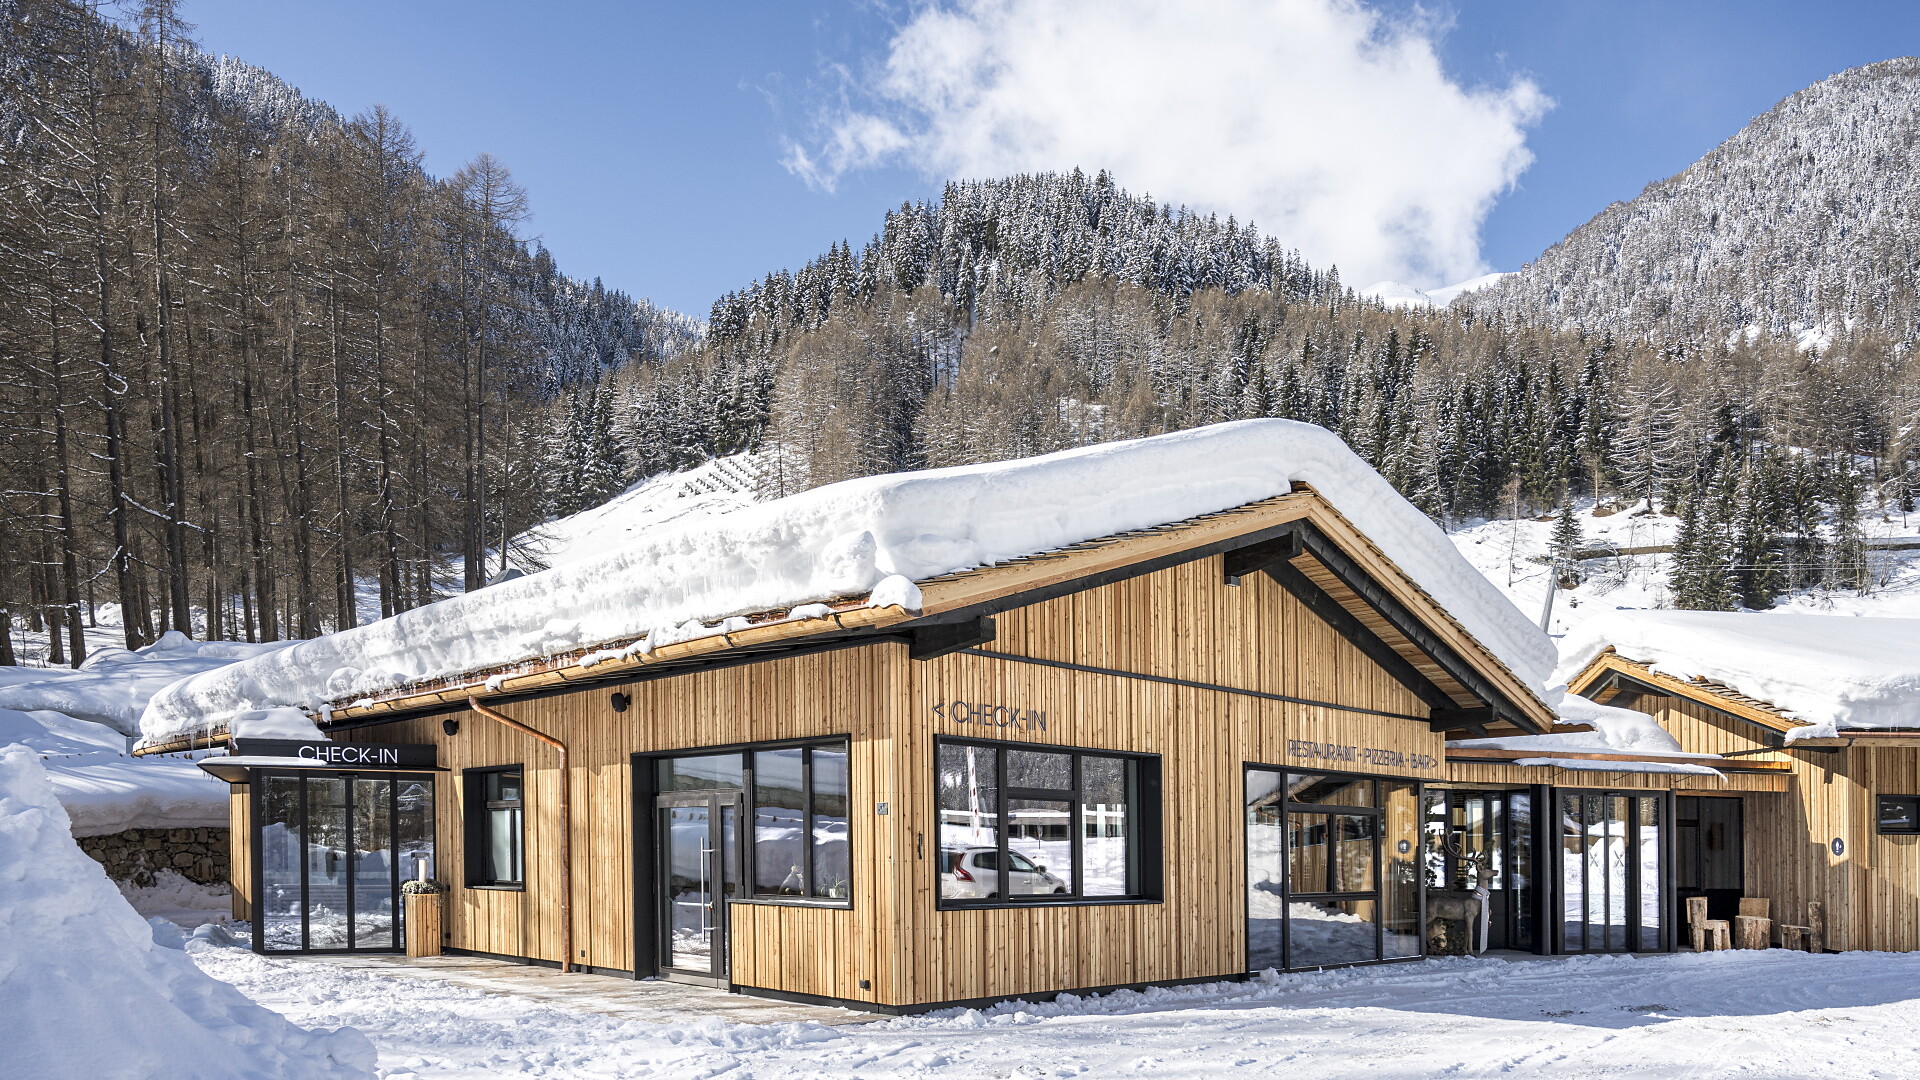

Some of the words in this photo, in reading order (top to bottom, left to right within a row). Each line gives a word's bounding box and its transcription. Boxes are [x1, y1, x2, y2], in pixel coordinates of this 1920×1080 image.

[951, 701, 1046, 731] CHECK-IN
[298, 745, 398, 764] CHECK-IN
[1287, 739, 1357, 763] RESTAURANT
[1363, 748, 1406, 768] PIZZERIA
[1410, 753, 1432, 770] BAR
